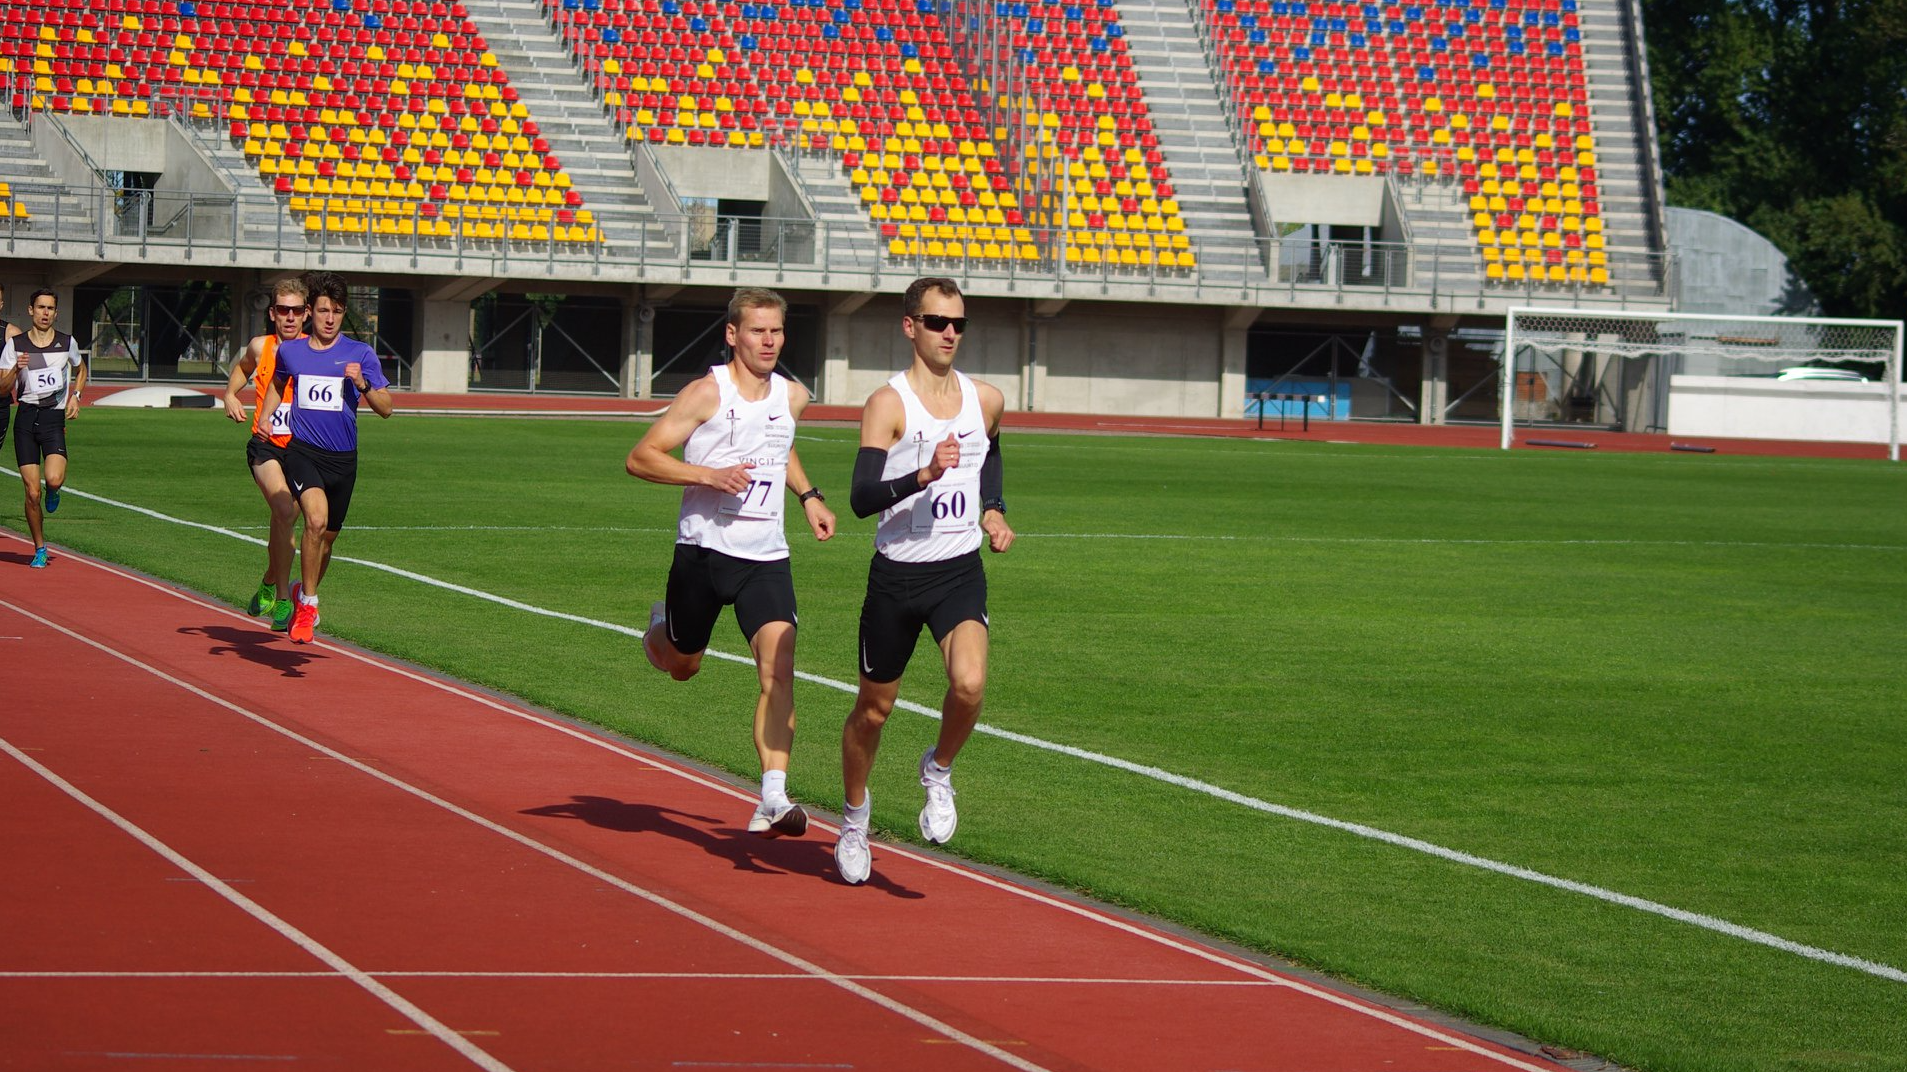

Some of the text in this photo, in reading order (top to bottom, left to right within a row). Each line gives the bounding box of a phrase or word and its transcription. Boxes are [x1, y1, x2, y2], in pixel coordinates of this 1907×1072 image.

[38, 372, 56, 388] 56
[308, 383, 333, 403] 66
[739, 457, 775, 466] VINCIT
[742, 480, 773, 507] 77
[931, 491, 966, 519] 60
